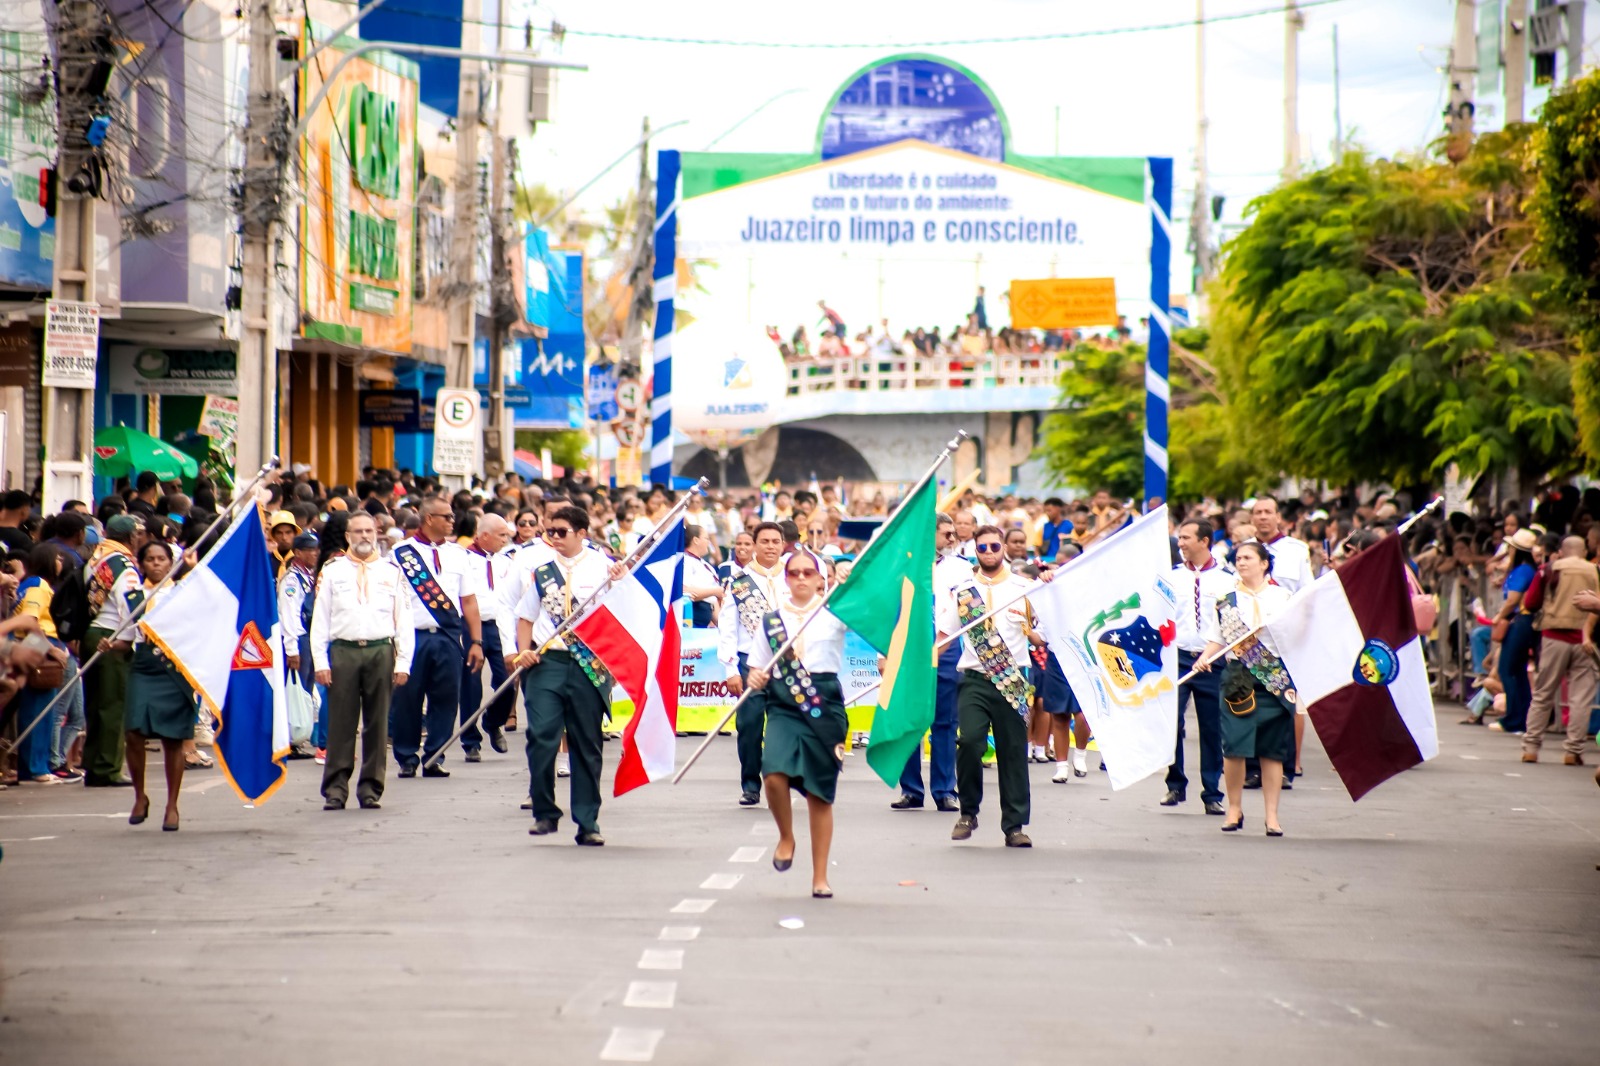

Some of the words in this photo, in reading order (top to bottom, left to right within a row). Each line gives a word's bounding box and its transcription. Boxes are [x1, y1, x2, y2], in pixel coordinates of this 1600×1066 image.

[829, 173, 903, 190] Liberdade
[908, 172, 917, 189] é
[922, 175, 931, 189] o
[936, 173, 997, 189] cuidado
[812, 196, 845, 210] com
[850, 196, 859, 210] o
[864, 195, 909, 210] futuro
[914, 195, 932, 210] do
[741, 216, 841, 242] Juazeiro
[850, 216, 914, 245] limpa
[924, 220, 936, 242] e
[945, 216, 1083, 244] consciente.
[452, 402, 465, 420] E
[704, 402, 768, 415] JUAZEIRO
[681, 664, 695, 677] DE
[679, 681, 741, 698] UREIRO
